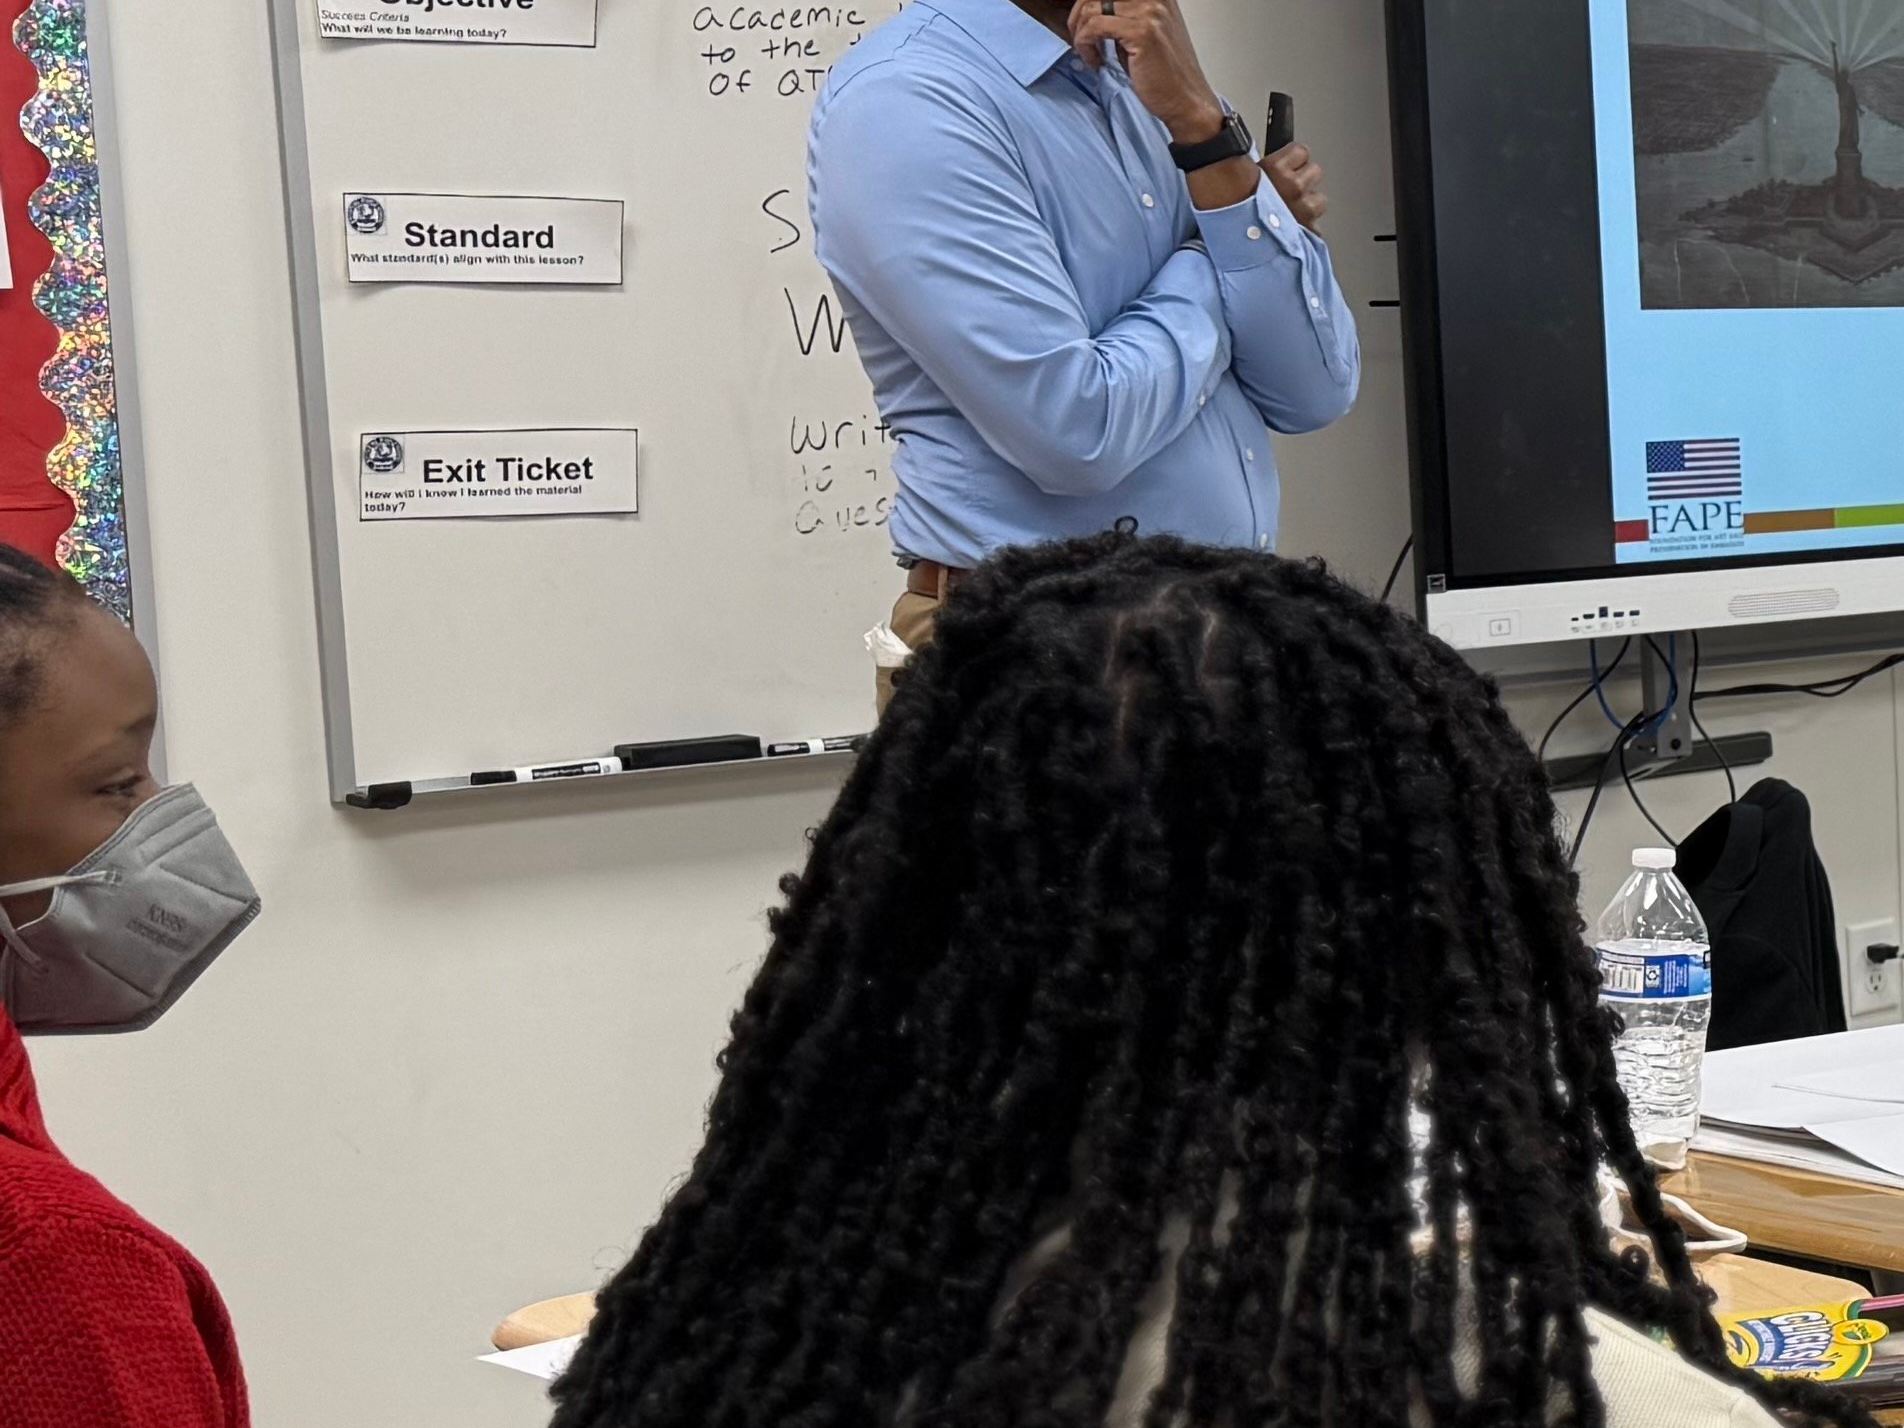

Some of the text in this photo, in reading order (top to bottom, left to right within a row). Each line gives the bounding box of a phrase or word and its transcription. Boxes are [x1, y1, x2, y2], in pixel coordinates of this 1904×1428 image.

[321, 10, 410, 22] Success Criteria
[694, 7, 865, 30] academic
[322, 23, 507, 40] What will we be learning today?
[701, 37, 820, 64] to the
[762, 189, 800, 253] S
[404, 221, 555, 249] Standard
[351, 253, 379, 263] What
[453, 255, 482, 266] align
[486, 255, 511, 265] with
[513, 255, 535, 265] this
[539, 255, 584, 265] lesson?
[423, 456, 594, 484] Exit Ticket
[365, 491, 391, 500] How
[394, 490, 415, 499] will
[425, 488, 458, 498] know
[468, 487, 511, 497] learned
[514, 486, 533, 496] the
[536, 485, 582, 495] material
[364, 501, 406, 513] today?
[1648, 501, 1744, 534] FAPE
